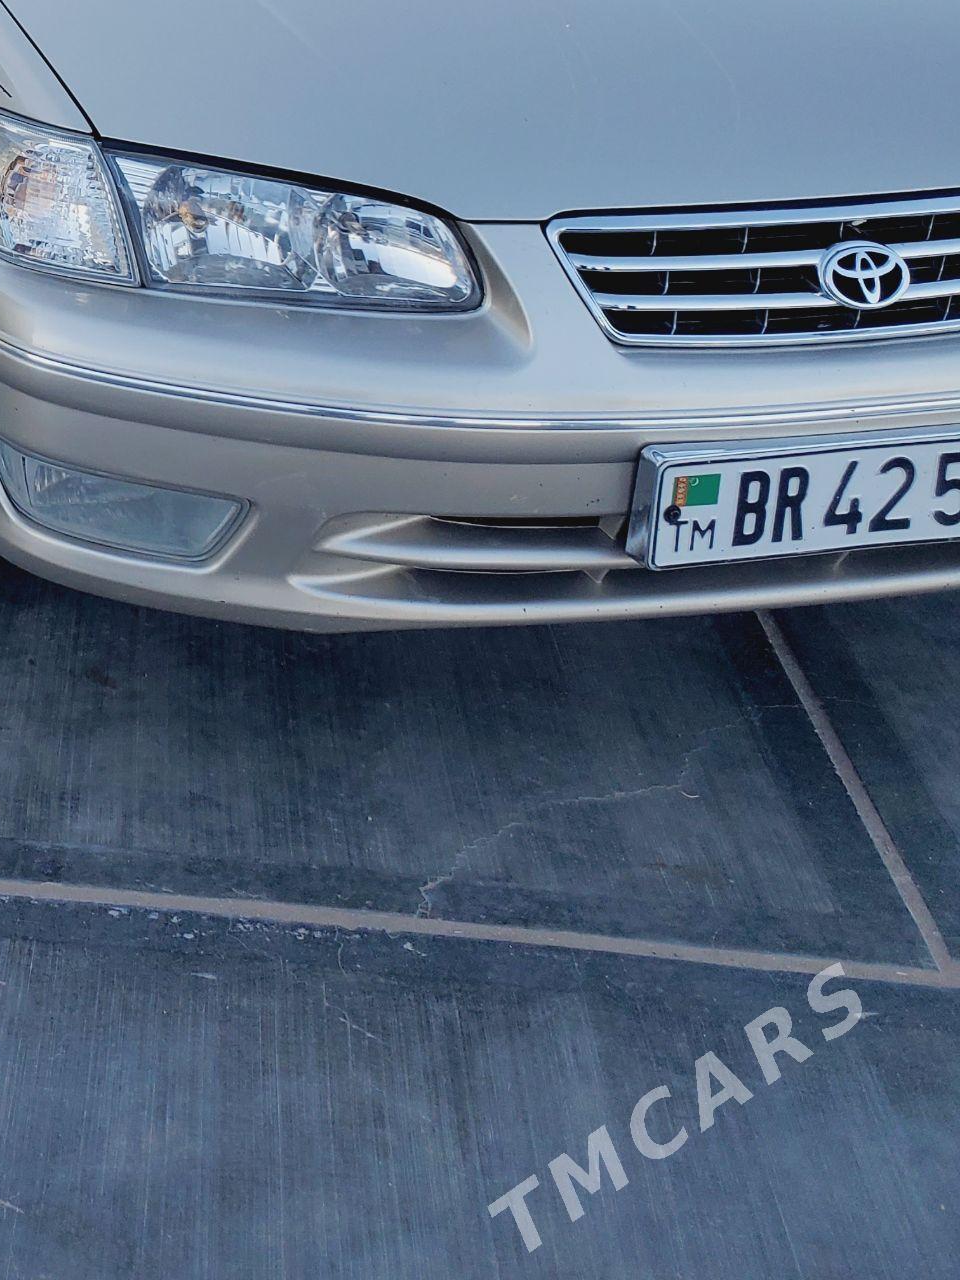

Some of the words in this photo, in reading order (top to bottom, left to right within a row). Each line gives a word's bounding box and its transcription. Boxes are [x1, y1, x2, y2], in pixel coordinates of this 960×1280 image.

[732, 466, 810, 546] BR
[823, 452, 960, 535] 425
[666, 519, 716, 553] TM
